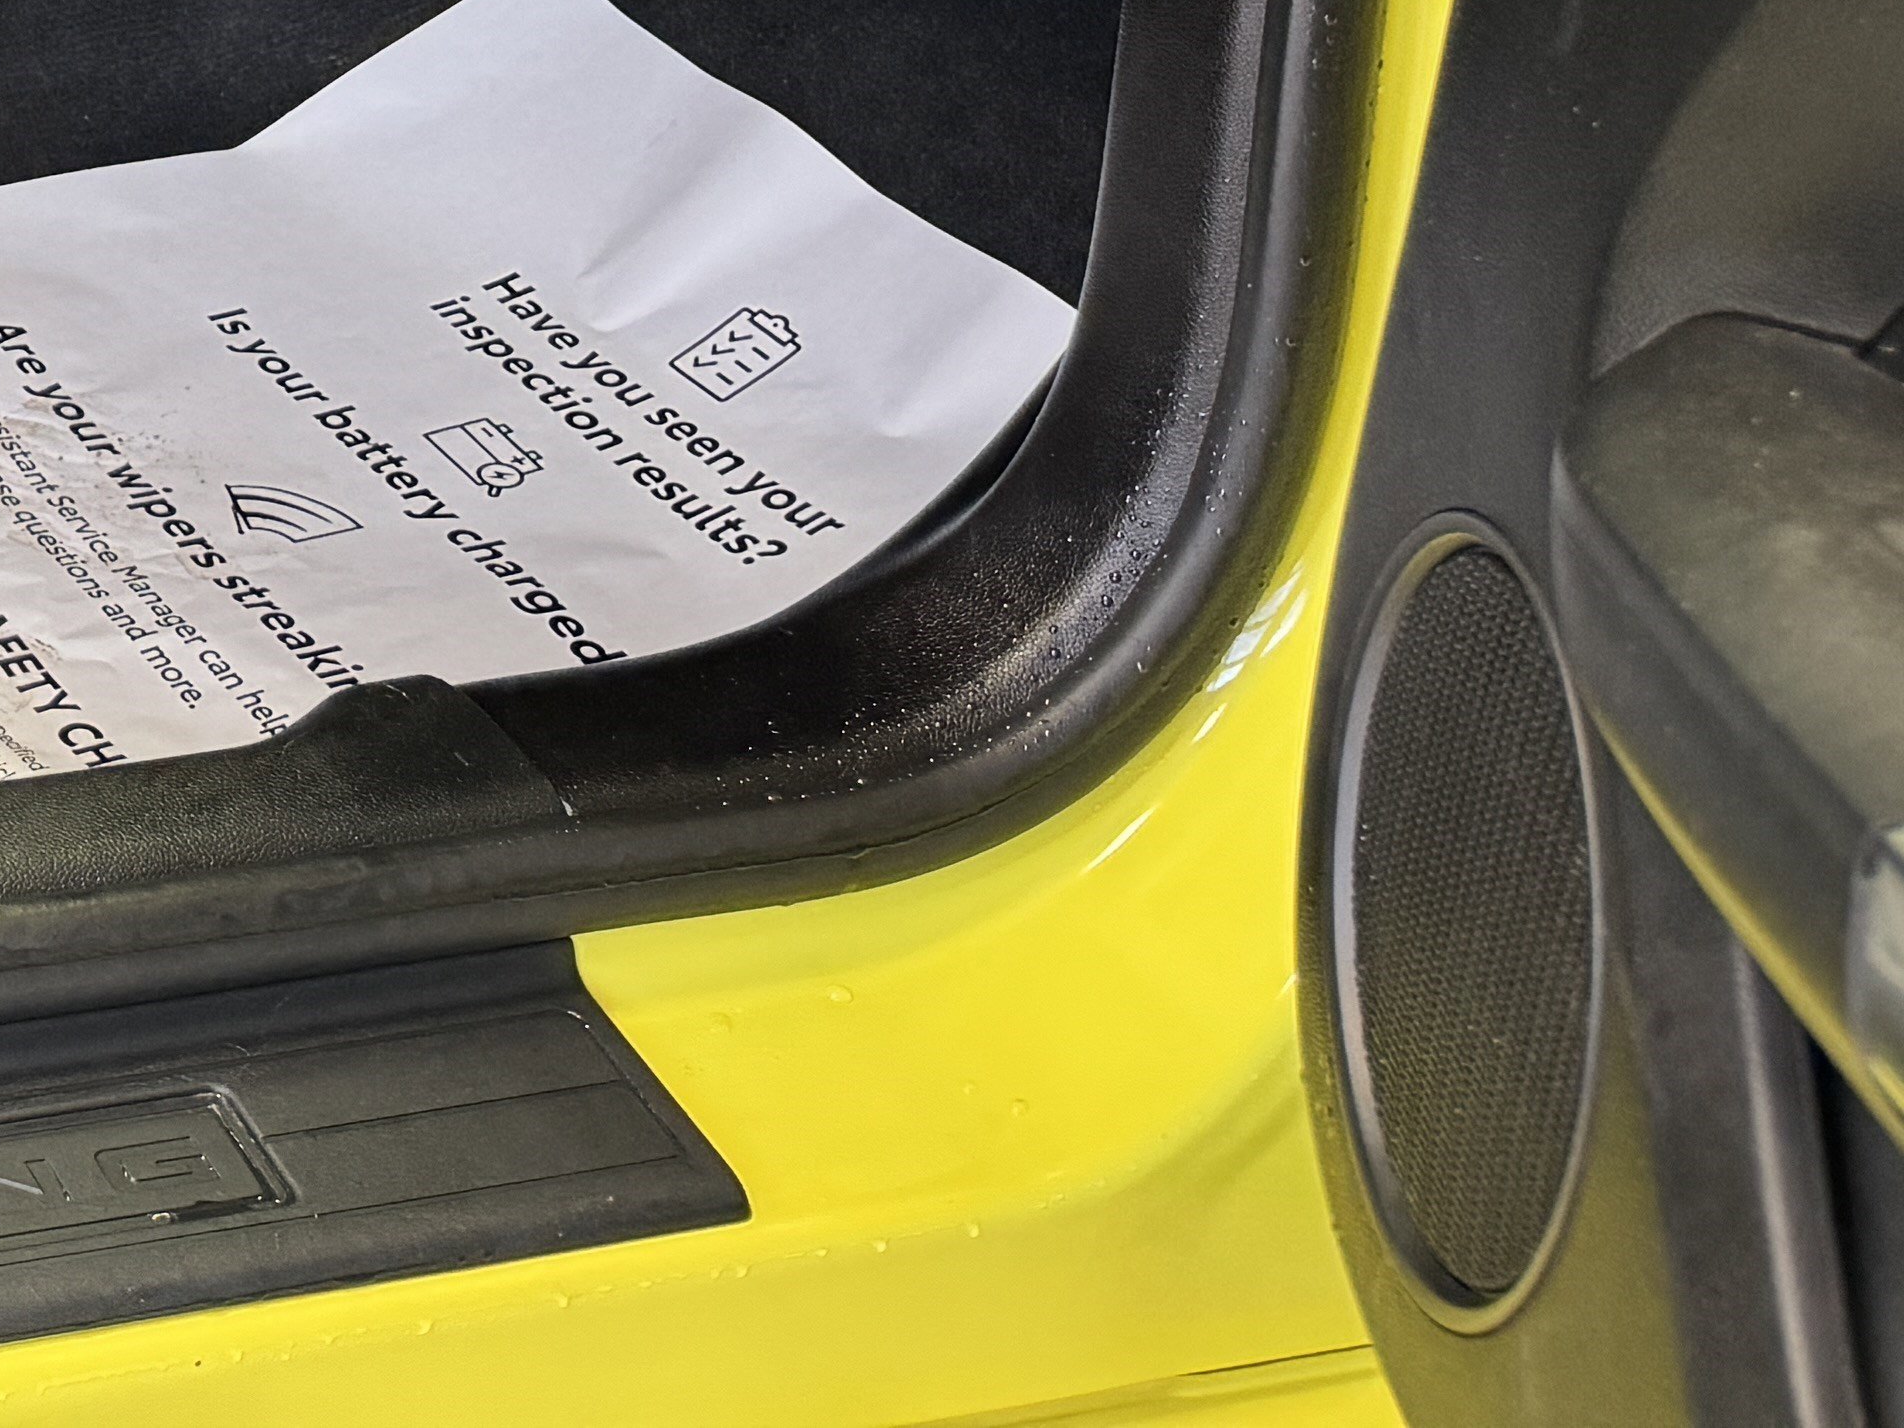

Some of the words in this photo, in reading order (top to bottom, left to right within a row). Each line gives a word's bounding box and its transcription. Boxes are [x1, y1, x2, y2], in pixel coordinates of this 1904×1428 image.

[207, 308, 252, 335] Is
[226, 338, 330, 402] your
[481, 272, 580, 350] Have
[559, 350, 655, 407] you
[643, 407, 746, 476] seen
[724, 471, 846, 536] your
[23, 382, 121, 455] your
[106, 462, 226, 568] wipers
[313, 405, 460, 520] battery
[430, 295, 624, 452] inspection
[613, 452, 788, 565] results?
[13, 510, 109, 599] questions
[102, 603, 158, 641] and
[141, 646, 202, 709] more.
[46, 495, 119, 563] Service
[112, 565, 207, 644] Manager
[198, 649, 244, 690] can
[446, 529, 628, 666] charged
